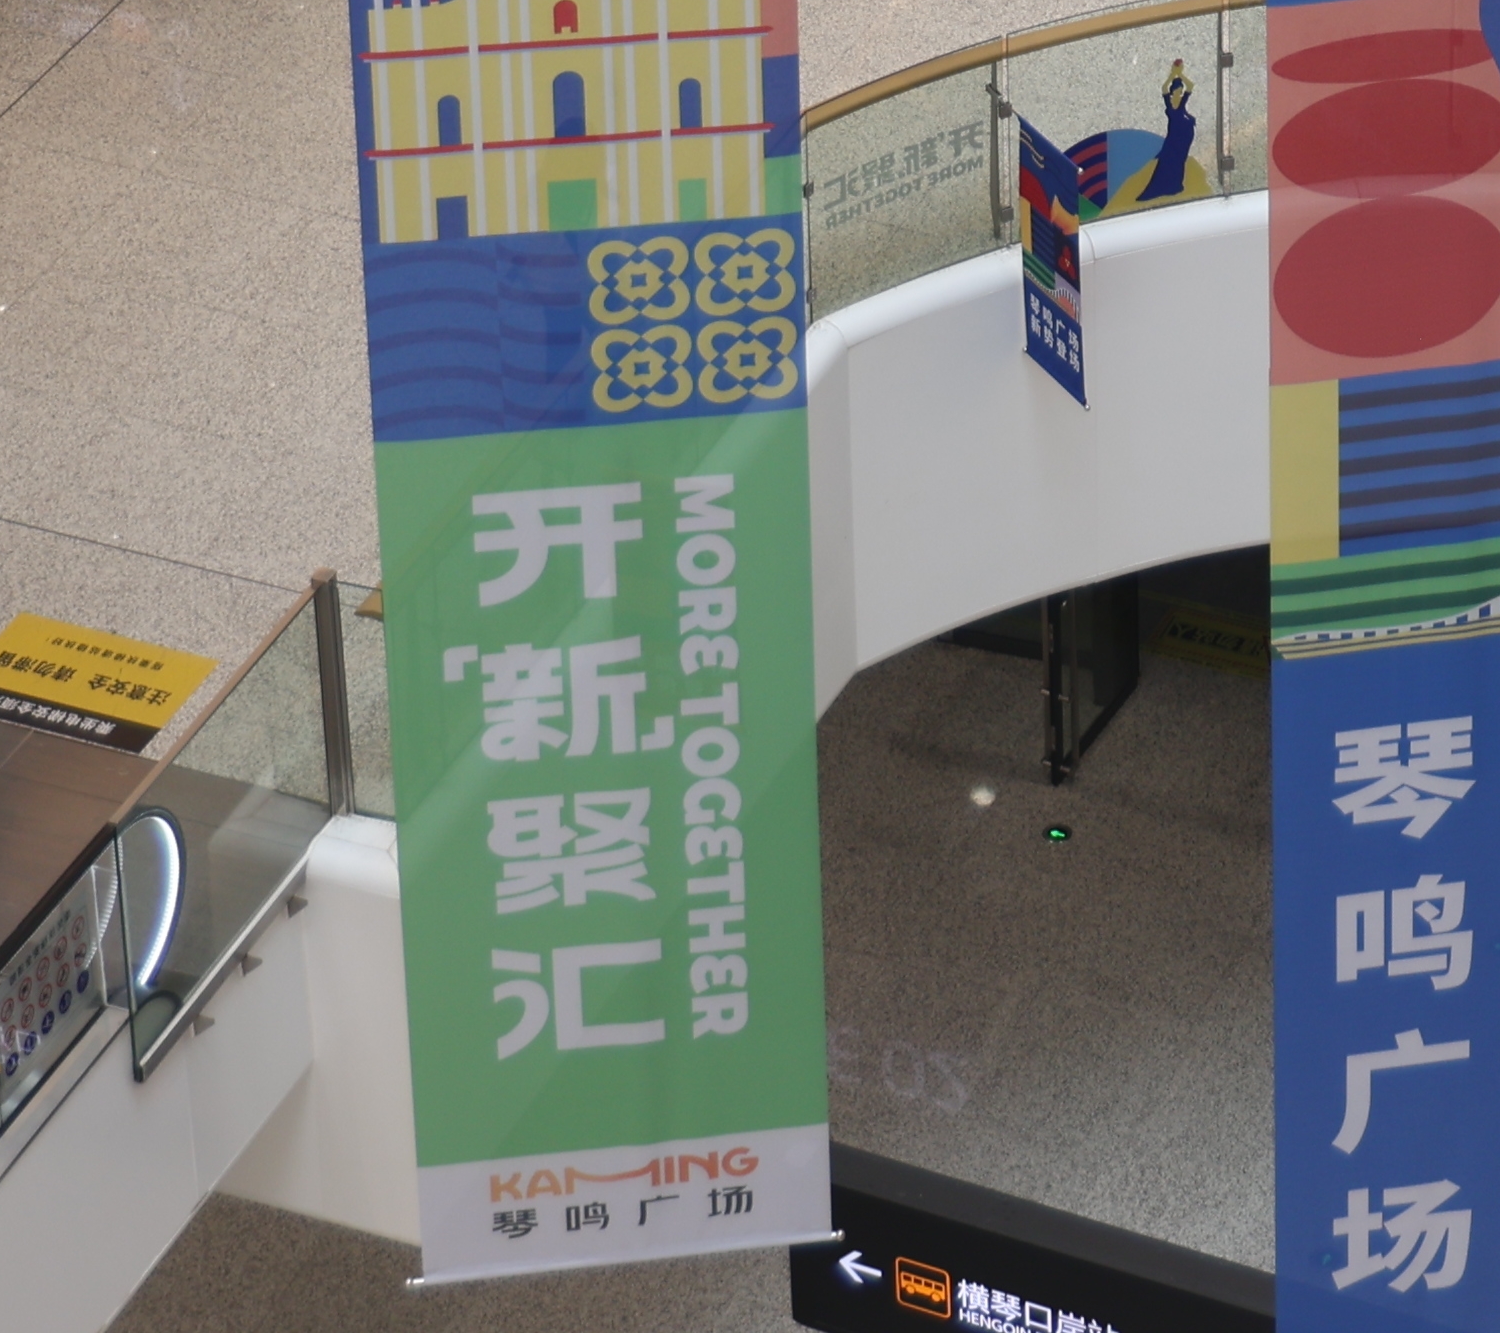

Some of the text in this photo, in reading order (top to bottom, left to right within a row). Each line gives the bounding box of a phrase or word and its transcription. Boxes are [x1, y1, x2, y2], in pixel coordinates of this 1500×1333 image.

[87, 672, 172, 707] 注意安全
[673, 473, 750, 1042] MORE TOGETHER
[1332, 715, 1477, 1293] 琴鸣广场
[492, 1184, 754, 1240] 琴鸣广场
